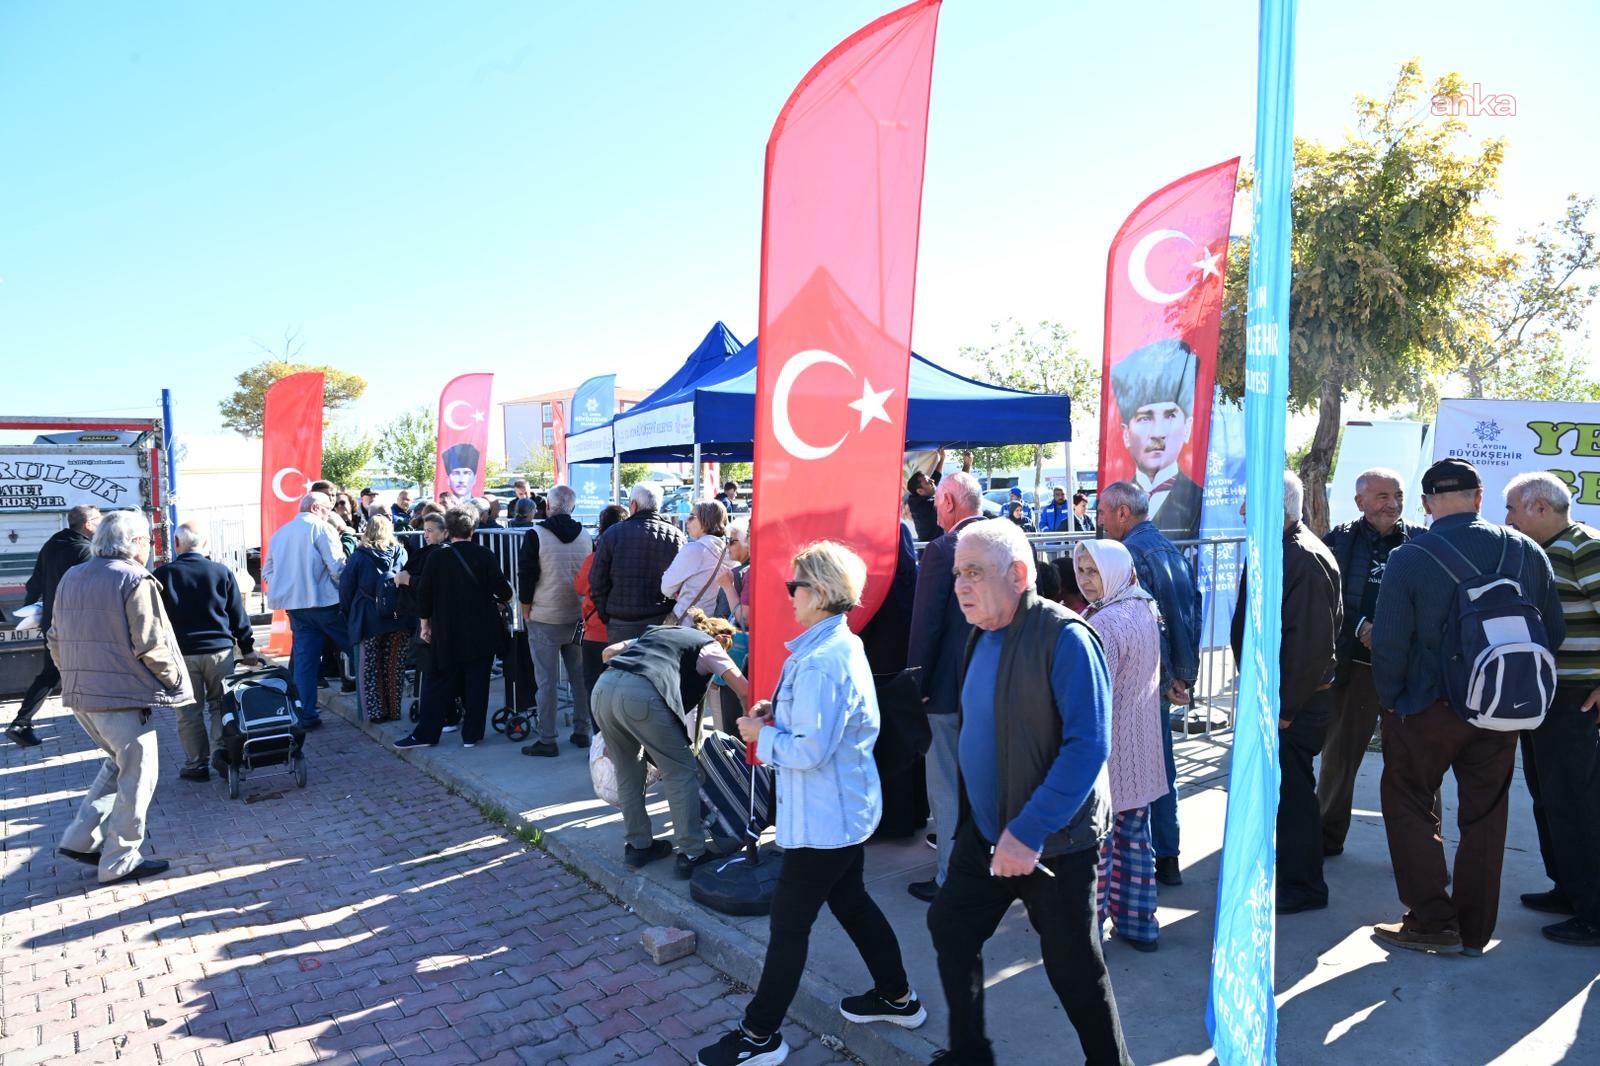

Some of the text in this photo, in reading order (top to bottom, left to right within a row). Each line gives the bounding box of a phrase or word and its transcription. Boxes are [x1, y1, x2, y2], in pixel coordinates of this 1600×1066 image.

[1449, 448, 1522, 460] BÜYÜKŞEHİR
[0, 484, 43, 497] ARET
[0, 496, 66, 510] RDEŞLER
